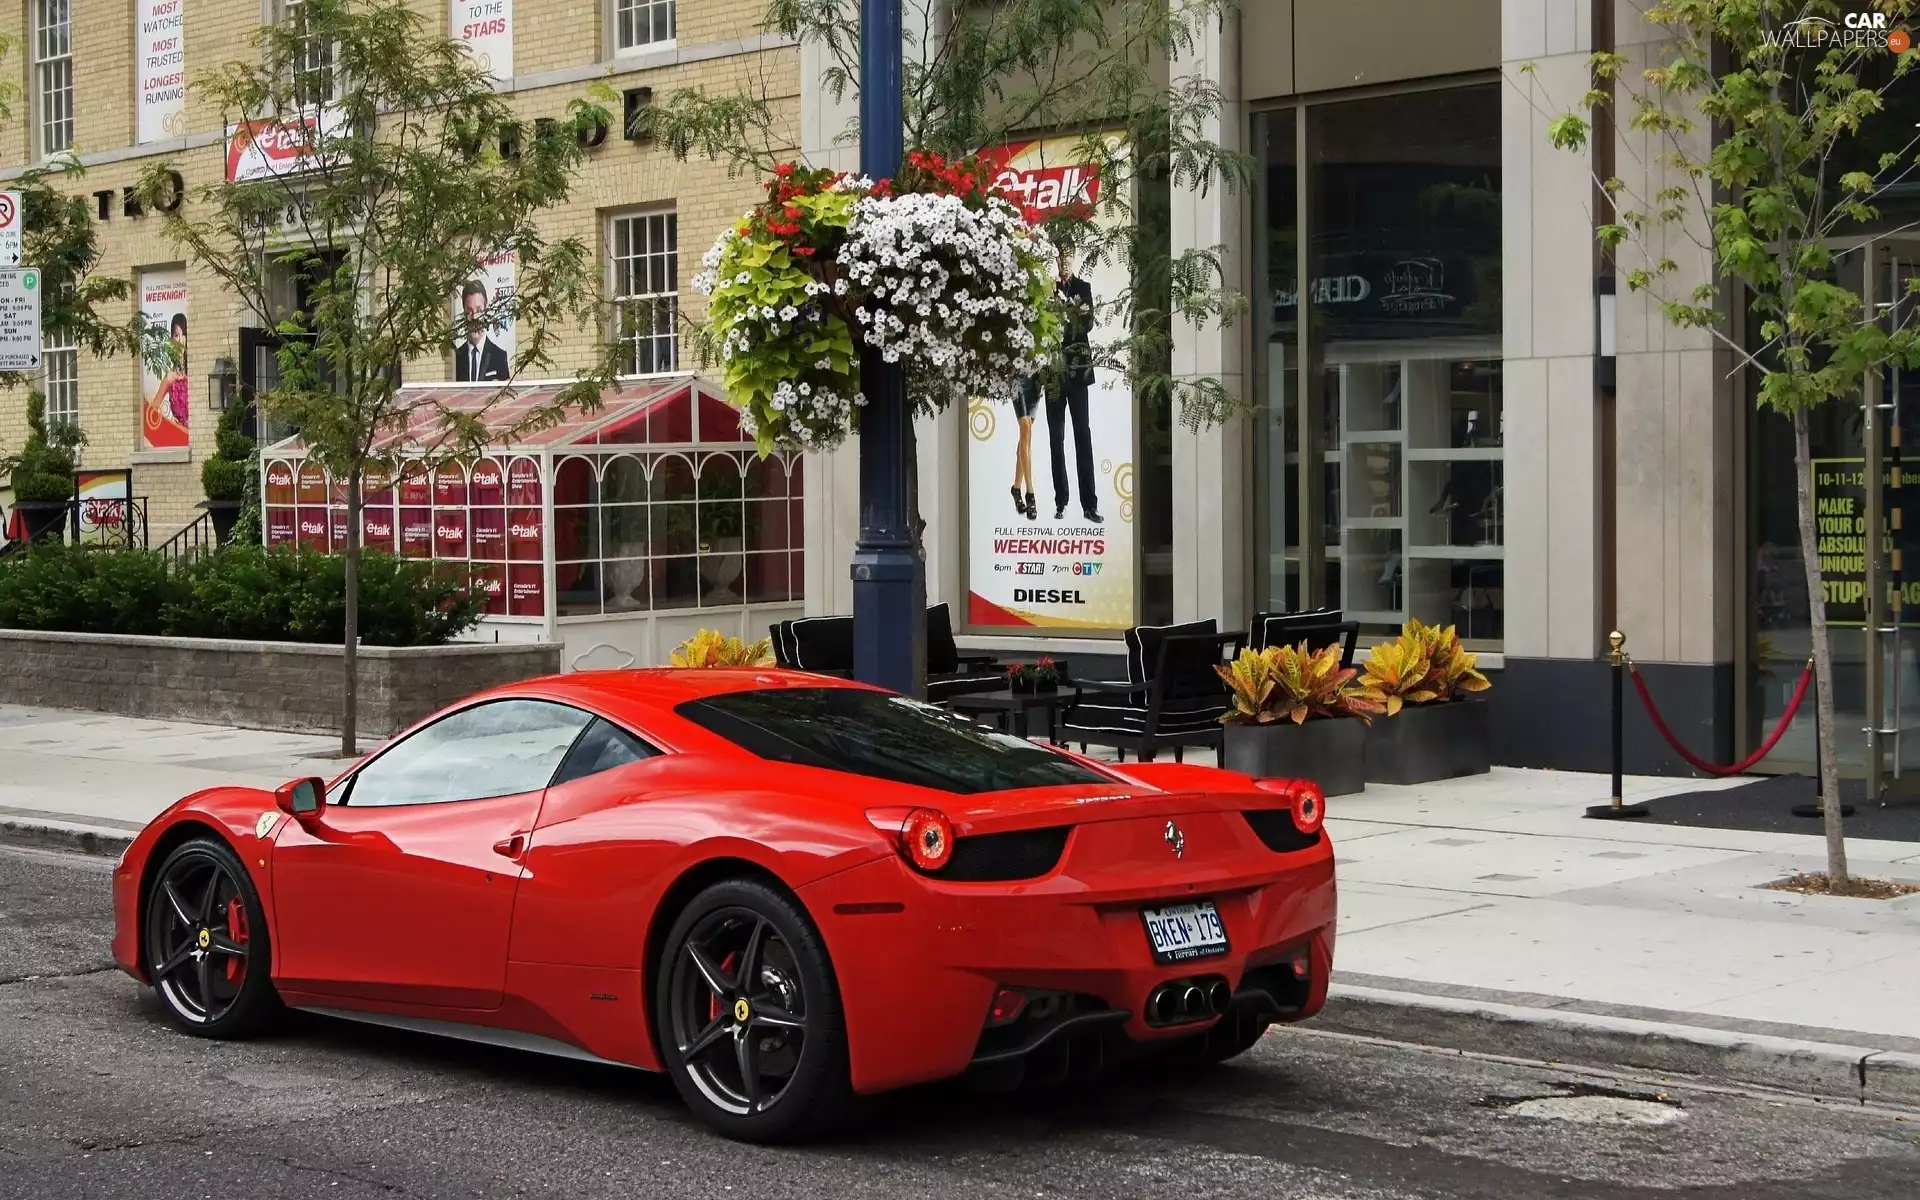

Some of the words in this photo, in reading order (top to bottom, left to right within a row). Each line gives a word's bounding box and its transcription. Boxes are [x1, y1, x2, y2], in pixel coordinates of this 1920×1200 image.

[152, 1, 178, 17] MOST
[469, 6, 482, 19] TO
[484, 2, 502, 16] THE
[462, 17, 506, 40] STARS
[152, 37, 178, 53] MOST
[146, 51, 184, 68] TRUSTED
[144, 71, 184, 90] LONGEST
[145, 86, 184, 105] RUNNING
[987, 168, 1092, 210] etalk
[286, 204, 296, 224] &
[5, 240, 18, 250] 6PM
[268, 473, 291, 486] etalk
[473, 472, 500, 486] etalk
[1818, 498, 1854, 515] MAKE
[301, 521, 324, 534] etalk
[366, 523, 390, 536] etalk
[437, 526, 463, 539] etalk
[511, 525, 539, 538] etalk
[994, 528, 1014, 536] FULL
[1017, 528, 1055, 536] FESTIVAL
[1057, 528, 1105, 537] COVERAGE
[1818, 517, 1851, 534] YOUR
[993, 539, 1106, 555] WEEKNIGHTS
[994, 564, 1012, 574] 6pm
[1052, 564, 1070, 574] 7pm
[1072, 562, 1103, 576] CTV
[1014, 588, 1086, 604] DIESEL
[1174, 948, 1199, 959] Ferrari
